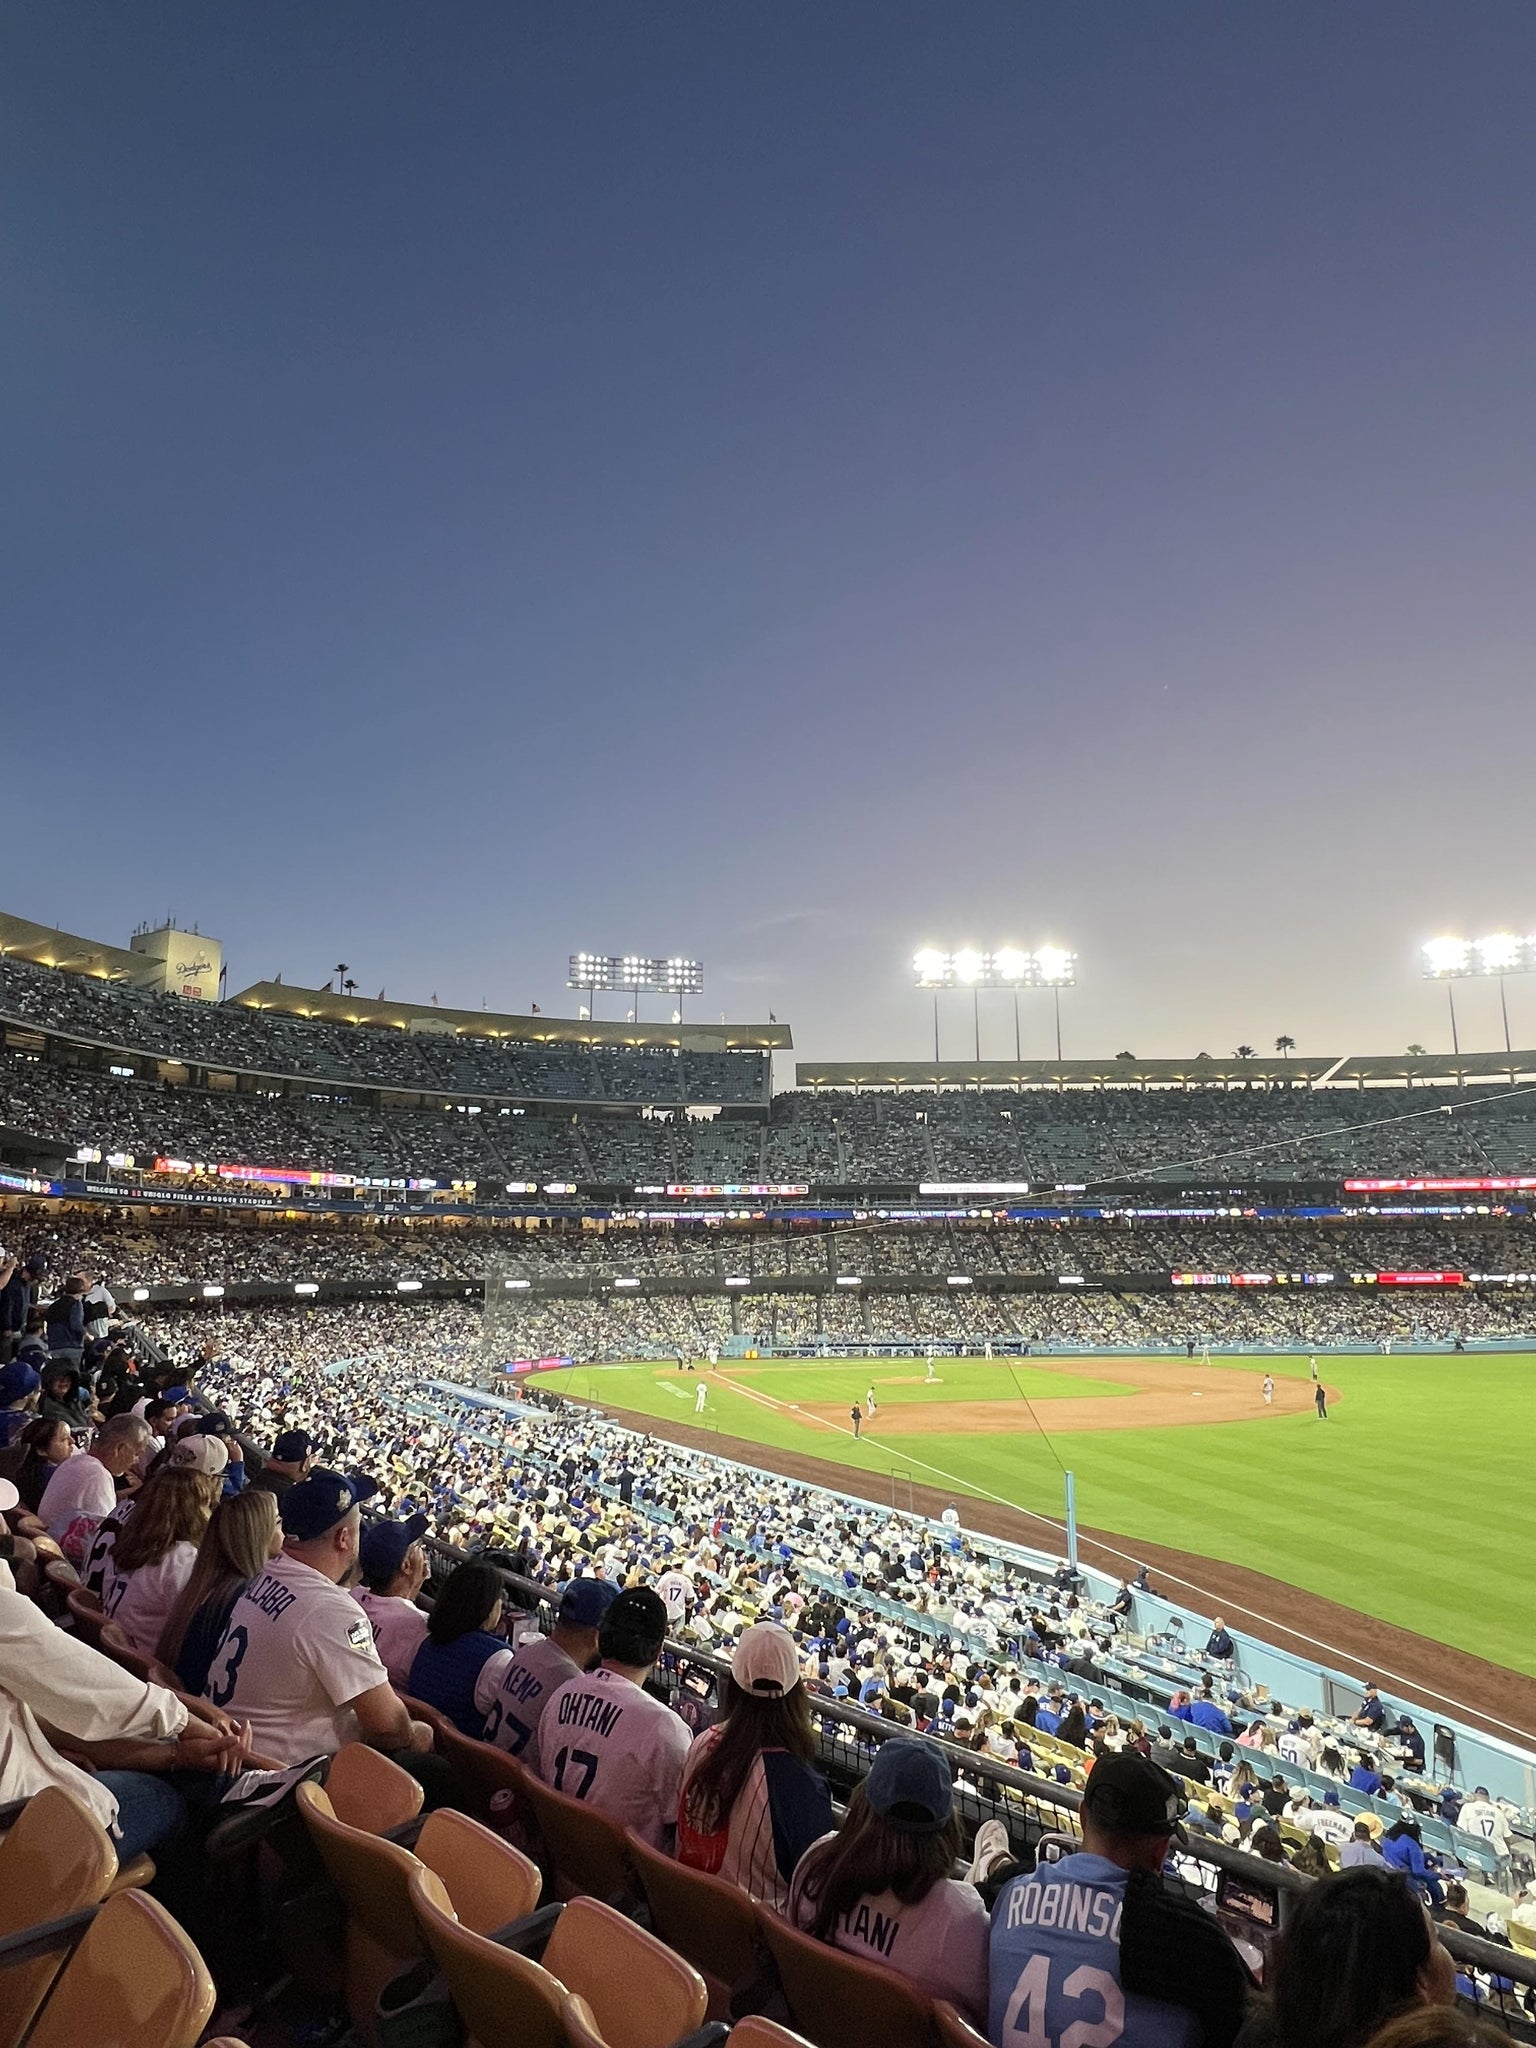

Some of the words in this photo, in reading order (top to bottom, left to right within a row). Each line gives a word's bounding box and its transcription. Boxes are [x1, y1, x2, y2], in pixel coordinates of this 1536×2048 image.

[176, 962, 212, 977] Dodgers
[670, 1587, 682, 1601] 17
[204, 1617, 248, 1708] 3
[502, 1664, 544, 1705] KEMP
[558, 1692, 624, 1738] OHTANI
[554, 1746, 599, 1800] 17
[1480, 1820, 1495, 1836] 17
[1002, 1954, 1125, 2048] 42
